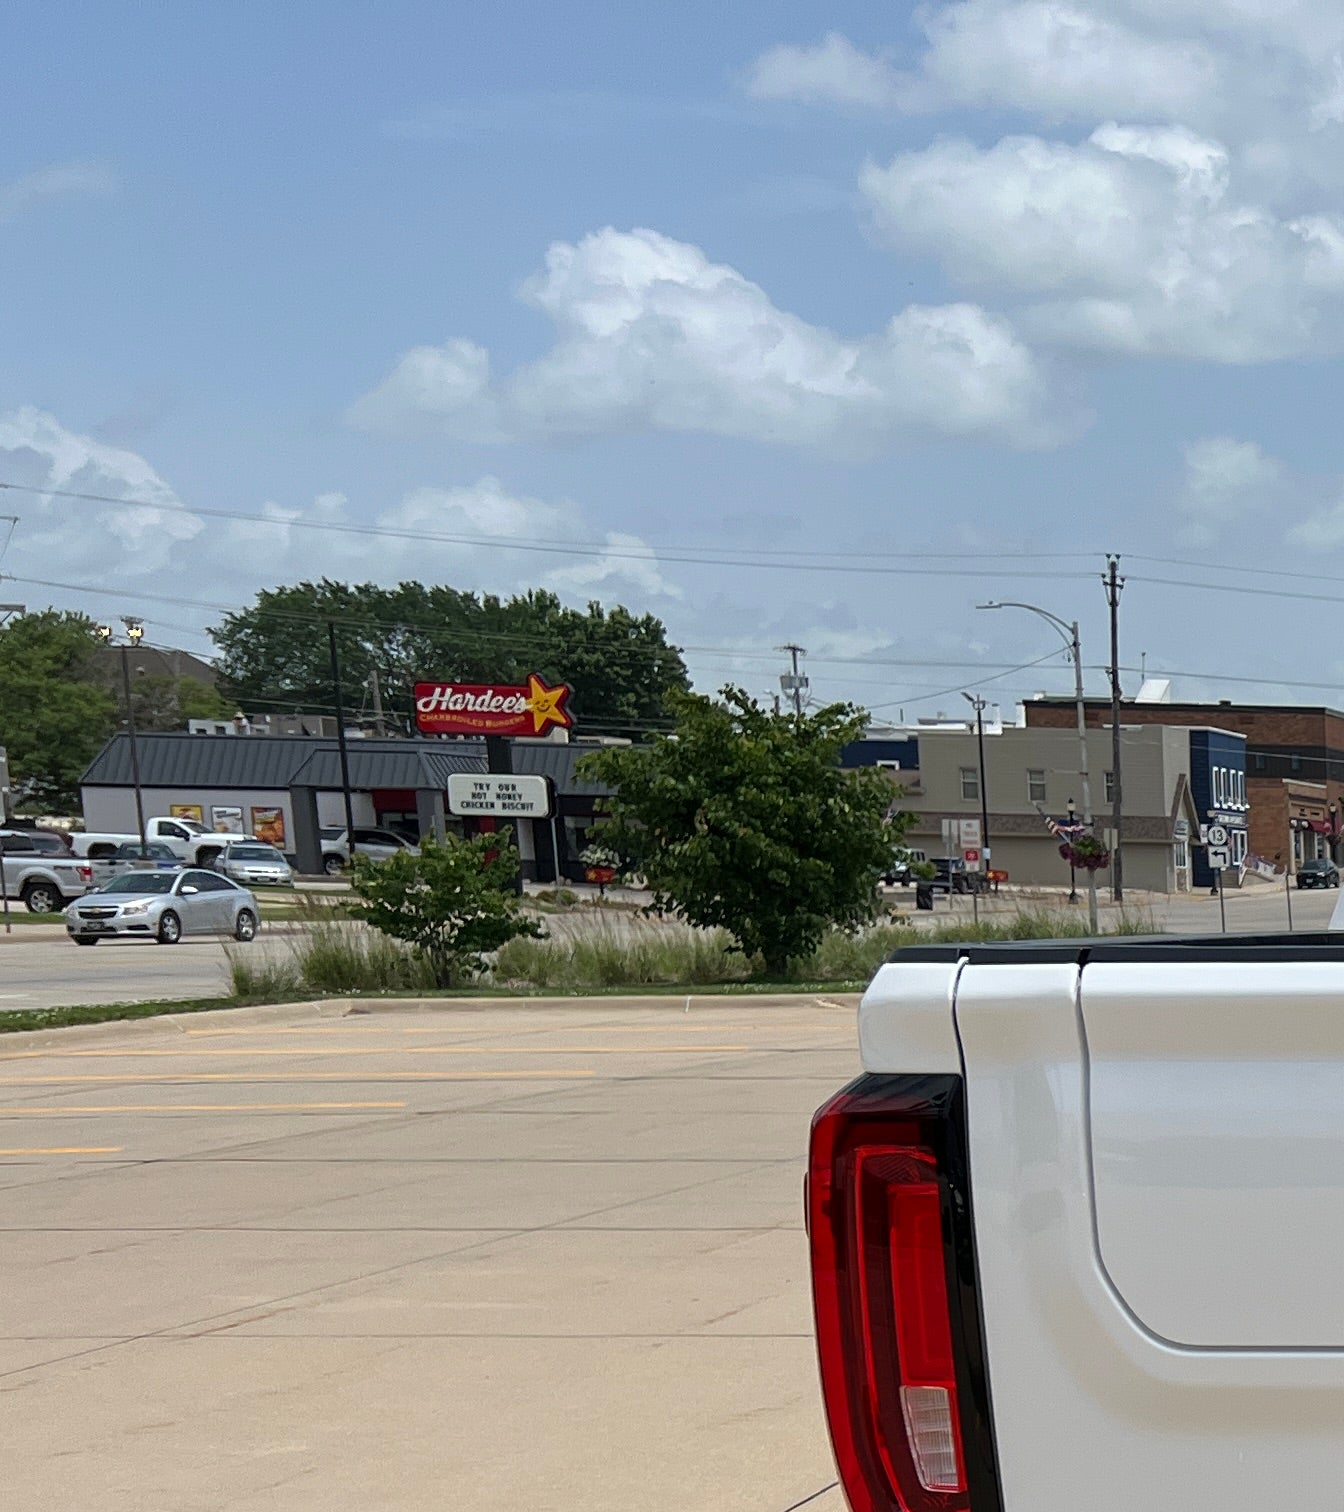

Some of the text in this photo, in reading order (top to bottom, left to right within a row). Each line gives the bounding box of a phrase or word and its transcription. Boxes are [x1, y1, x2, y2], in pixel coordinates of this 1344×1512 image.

[417, 687, 531, 714] Hardee's
[473, 782, 491, 791] TRY
[461, 801, 534, 811] CHICKEN BISCUIT
[1211, 829, 1224, 842] 13
